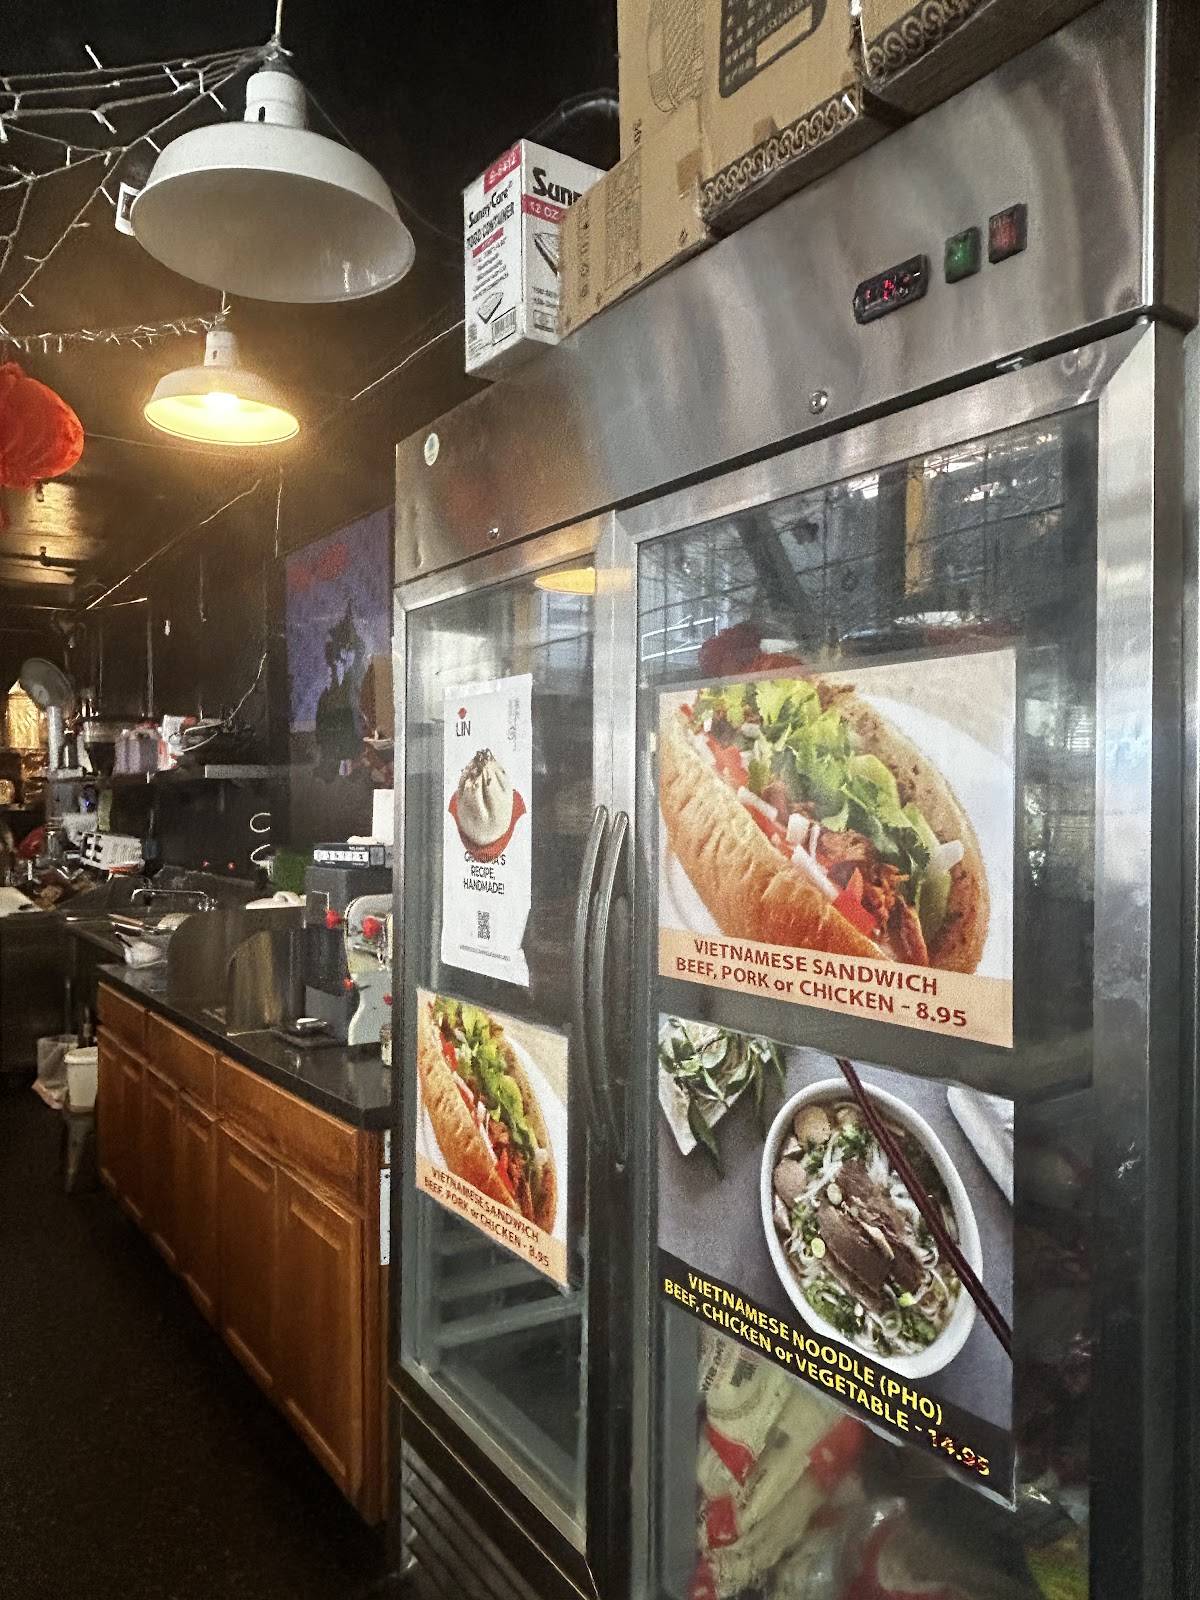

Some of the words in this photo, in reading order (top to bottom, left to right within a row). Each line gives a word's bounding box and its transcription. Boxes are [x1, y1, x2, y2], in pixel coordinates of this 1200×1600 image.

[544, 206, 560, 221] OZ
[456, 720, 471, 737] LIN
[463, 878, 505, 895] HANDMADE!
[470, 865, 496, 881] RECIPE,
[693, 939, 808, 973] VIETNAMESE
[813, 958, 938, 996] SANDWICH
[676, 957, 718, 980] BEEF,
[721, 965, 770, 989] PORK
[773, 980, 794, 993] or
[799, 980, 895, 1014] CHICKEN
[916, 1002, 968, 1027] 8.95
[431, 1166, 484, 1210] VIETNAMESE
[484, 1201, 539, 1243] SANDWICH
[480, 1214, 521, 1249] CHICKEN
[688, 1272, 790, 1341] VIETNAMESE
[792, 1330, 876, 1388] NOODLE
[879, 1375, 943, 1426] (PHO)
[664, 1278, 700, 1313] BEEF,
[702, 1302, 772, 1353] CHICKEN
[775, 1346, 793, 1364] or
[795, 1353, 910, 1432] VEGETABLE
[927, 1428, 990, 1476] 14.95
